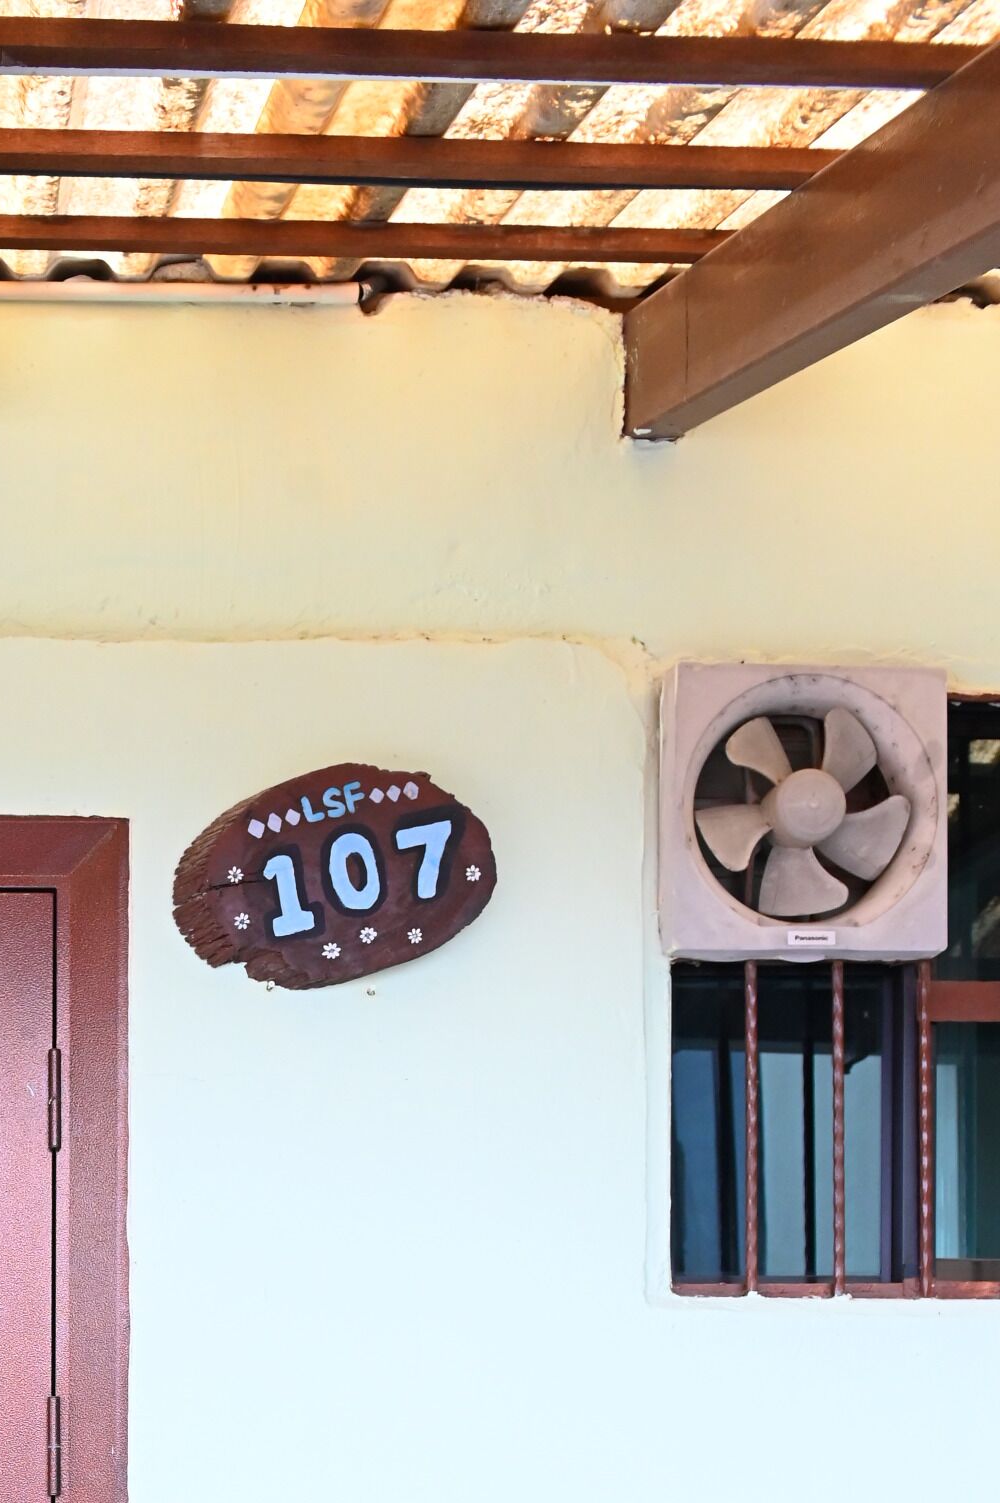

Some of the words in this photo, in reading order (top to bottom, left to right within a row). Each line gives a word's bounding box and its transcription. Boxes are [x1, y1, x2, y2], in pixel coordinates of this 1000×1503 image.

[300, 781, 365, 823] LSF
[263, 819, 452, 937] 107
[794, 934, 829, 942] Panasonic
